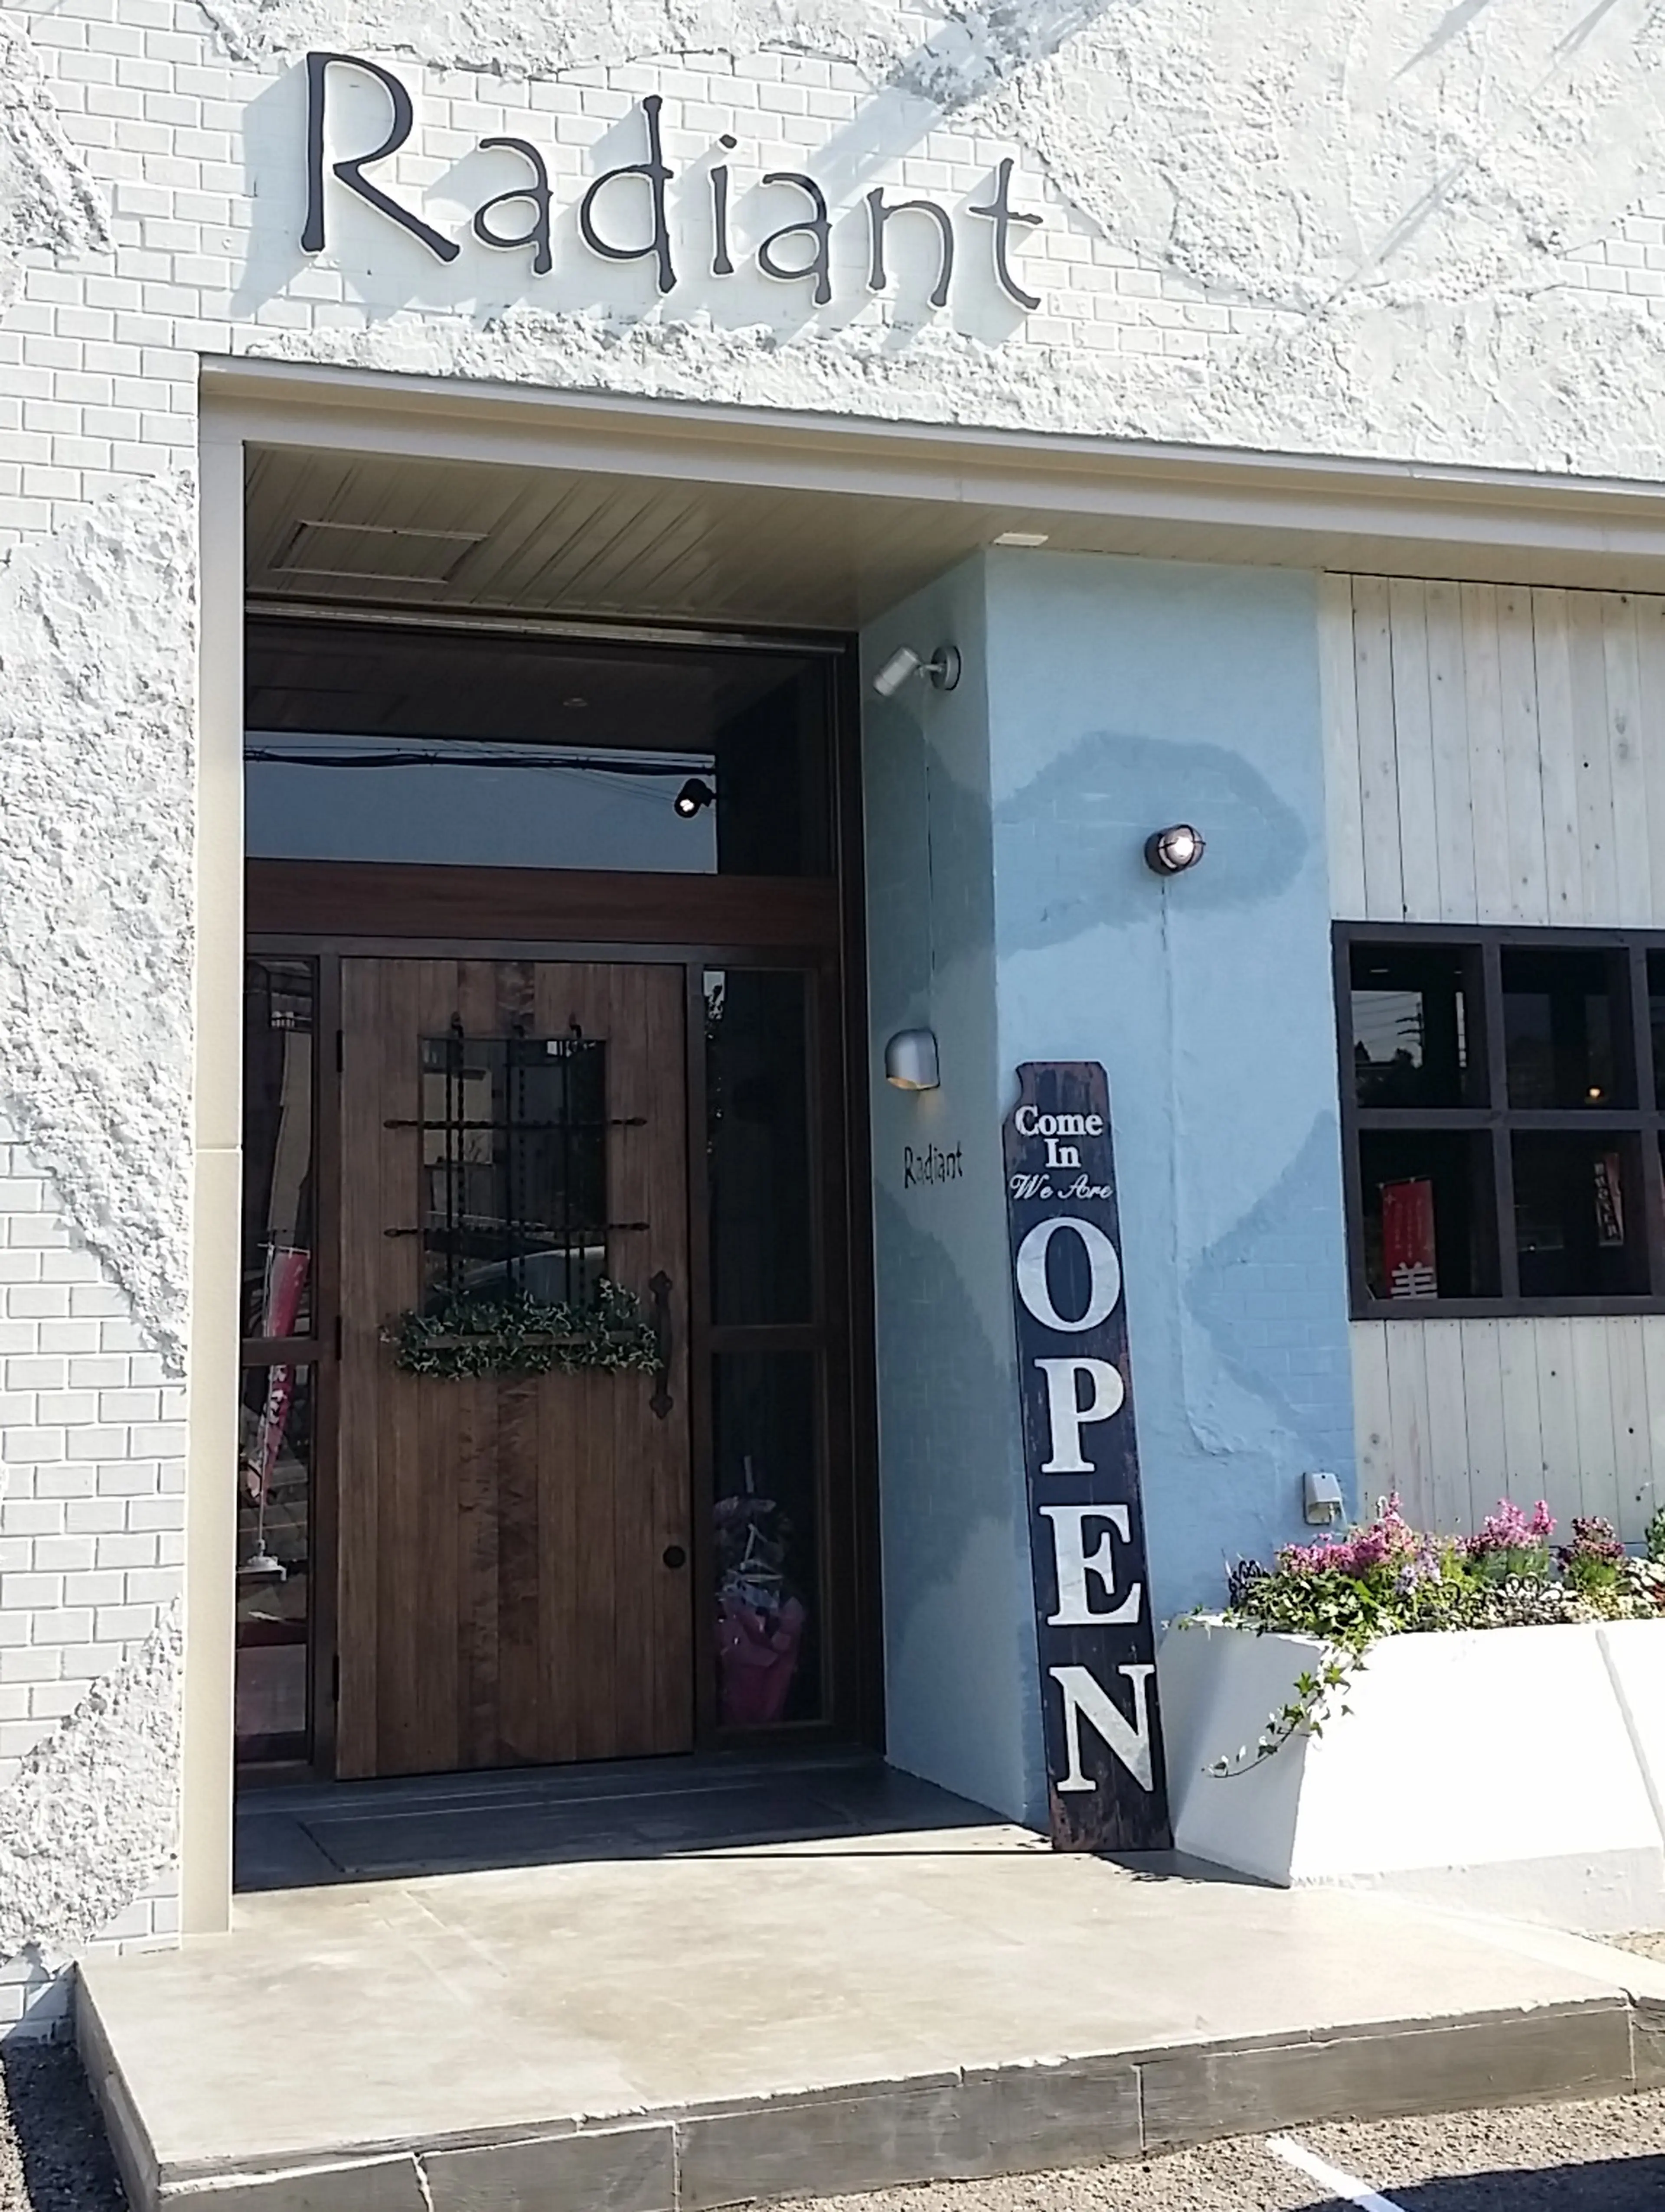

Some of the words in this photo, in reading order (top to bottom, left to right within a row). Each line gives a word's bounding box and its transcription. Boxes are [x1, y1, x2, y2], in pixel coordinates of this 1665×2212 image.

[301, 51, 1043, 310] Radiant
[1015, 1105, 1103, 1136] Come
[904, 1140, 963, 1189] Radiant
[1044, 1138, 1081, 1168] In
[1009, 1173, 1053, 1199] We
[1058, 1173, 1113, 1199] Are
[1016, 1217, 1155, 1792] OPEN
